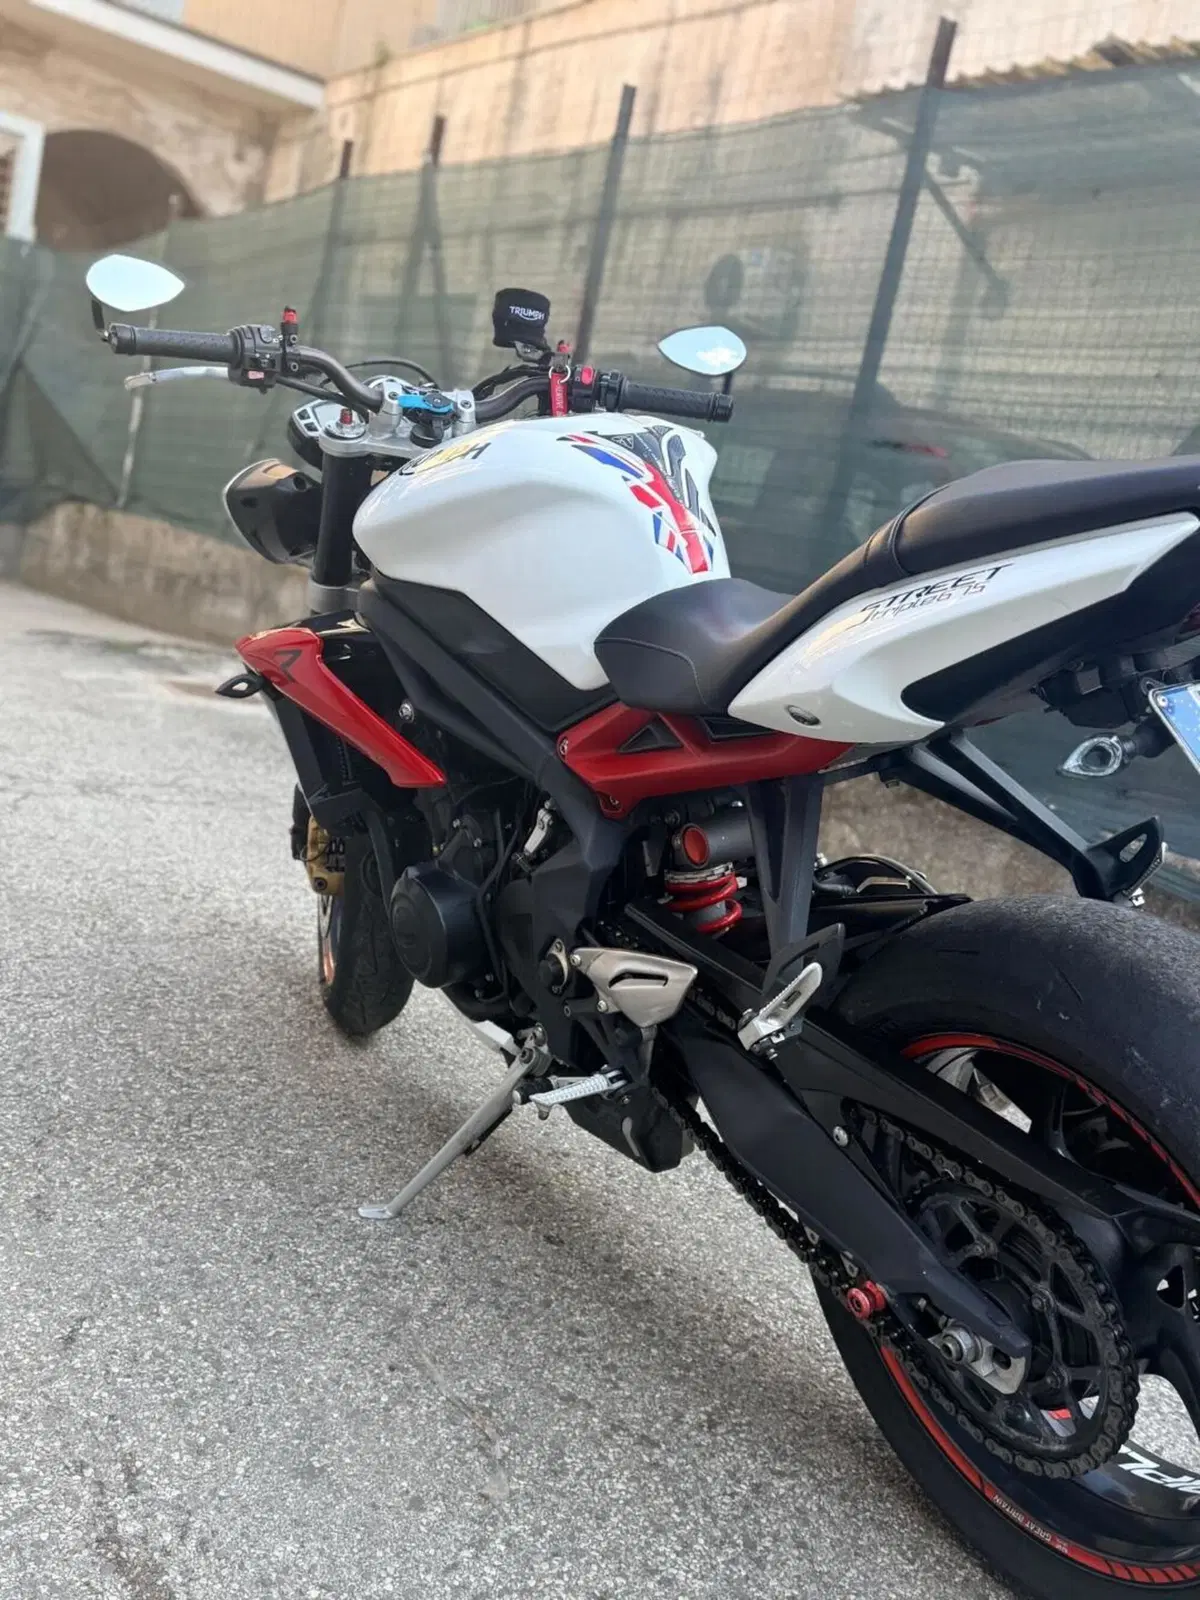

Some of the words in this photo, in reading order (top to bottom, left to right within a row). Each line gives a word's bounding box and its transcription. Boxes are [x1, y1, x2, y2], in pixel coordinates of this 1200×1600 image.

[509, 305, 545, 321] TRIUMPH
[853, 562, 1015, 625] STREET
[1118, 1444, 1200, 1494] IPL
[993, 1494, 1025, 1522] BRITAIN
[1025, 1520, 1052, 1542] GREAT
